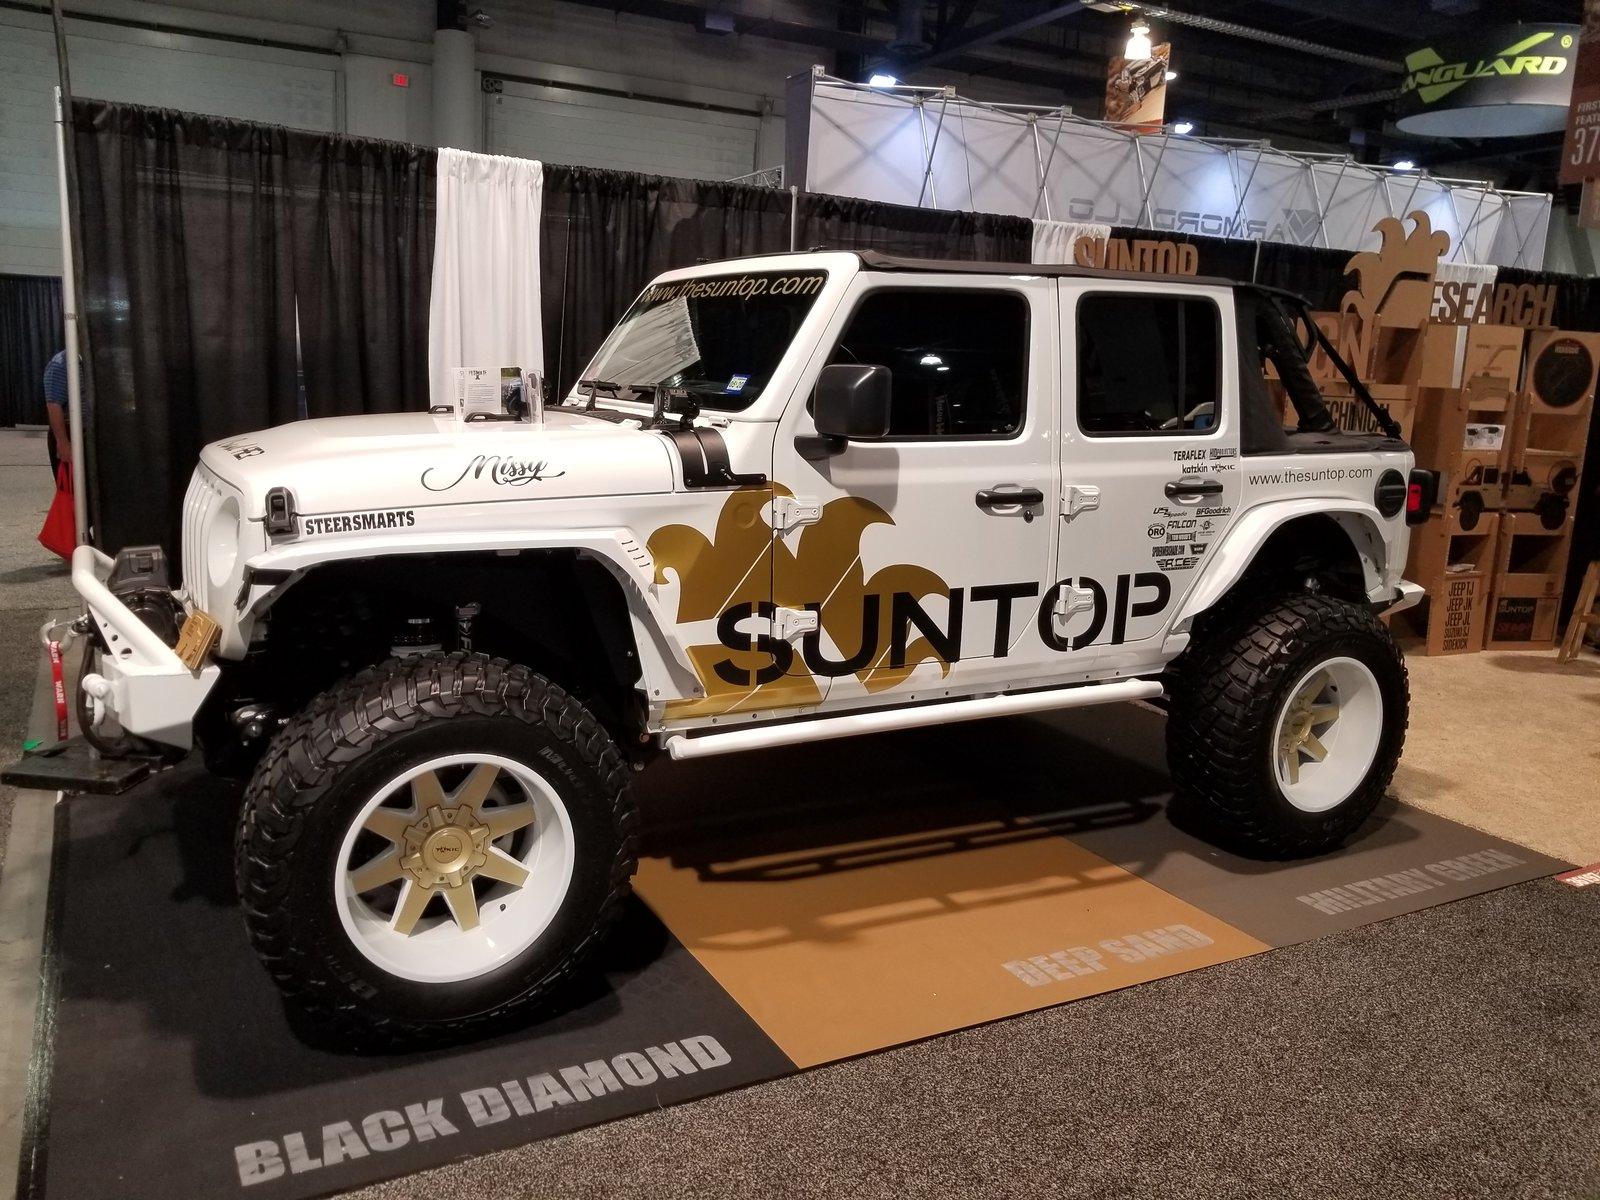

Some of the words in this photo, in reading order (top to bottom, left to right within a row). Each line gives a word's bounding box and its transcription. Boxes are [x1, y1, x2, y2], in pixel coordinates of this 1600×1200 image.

[1571, 126, 1600, 166] 37
[640, 275, 823, 304] www.thesuntop.com
[1429, 281, 1558, 328] ESEARCH
[1173, 450, 1207, 461] TERAFLEX
[1182, 462, 1208, 474] katzkin
[420, 455, 565, 491] Missy
[1249, 467, 1373, 486] www.thesuntop.com
[305, 510, 415, 535] STEERSMARTS
[1196, 507, 1232, 515] BFGoodrich
[1167, 519, 1197, 529] FALCON
[1448, 582, 1466, 597] JEEP
[1466, 581, 1475, 595] TJ
[1446, 598, 1463, 612] JEEP
[703, 572, 1171, 687] SUNTOP
[1444, 612, 1463, 627] JEEP
[1462, 611, 1471, 625] JL
[1296, 868, 1446, 915] MILITARY
[1424, 848, 1528, 882] GREEN
[1001, 946, 1108, 988] DEEP
[1097, 923, 1215, 964] SAND
[234, 1097, 460, 1187] BLACK
[461, 1034, 732, 1128] DIAMOND
